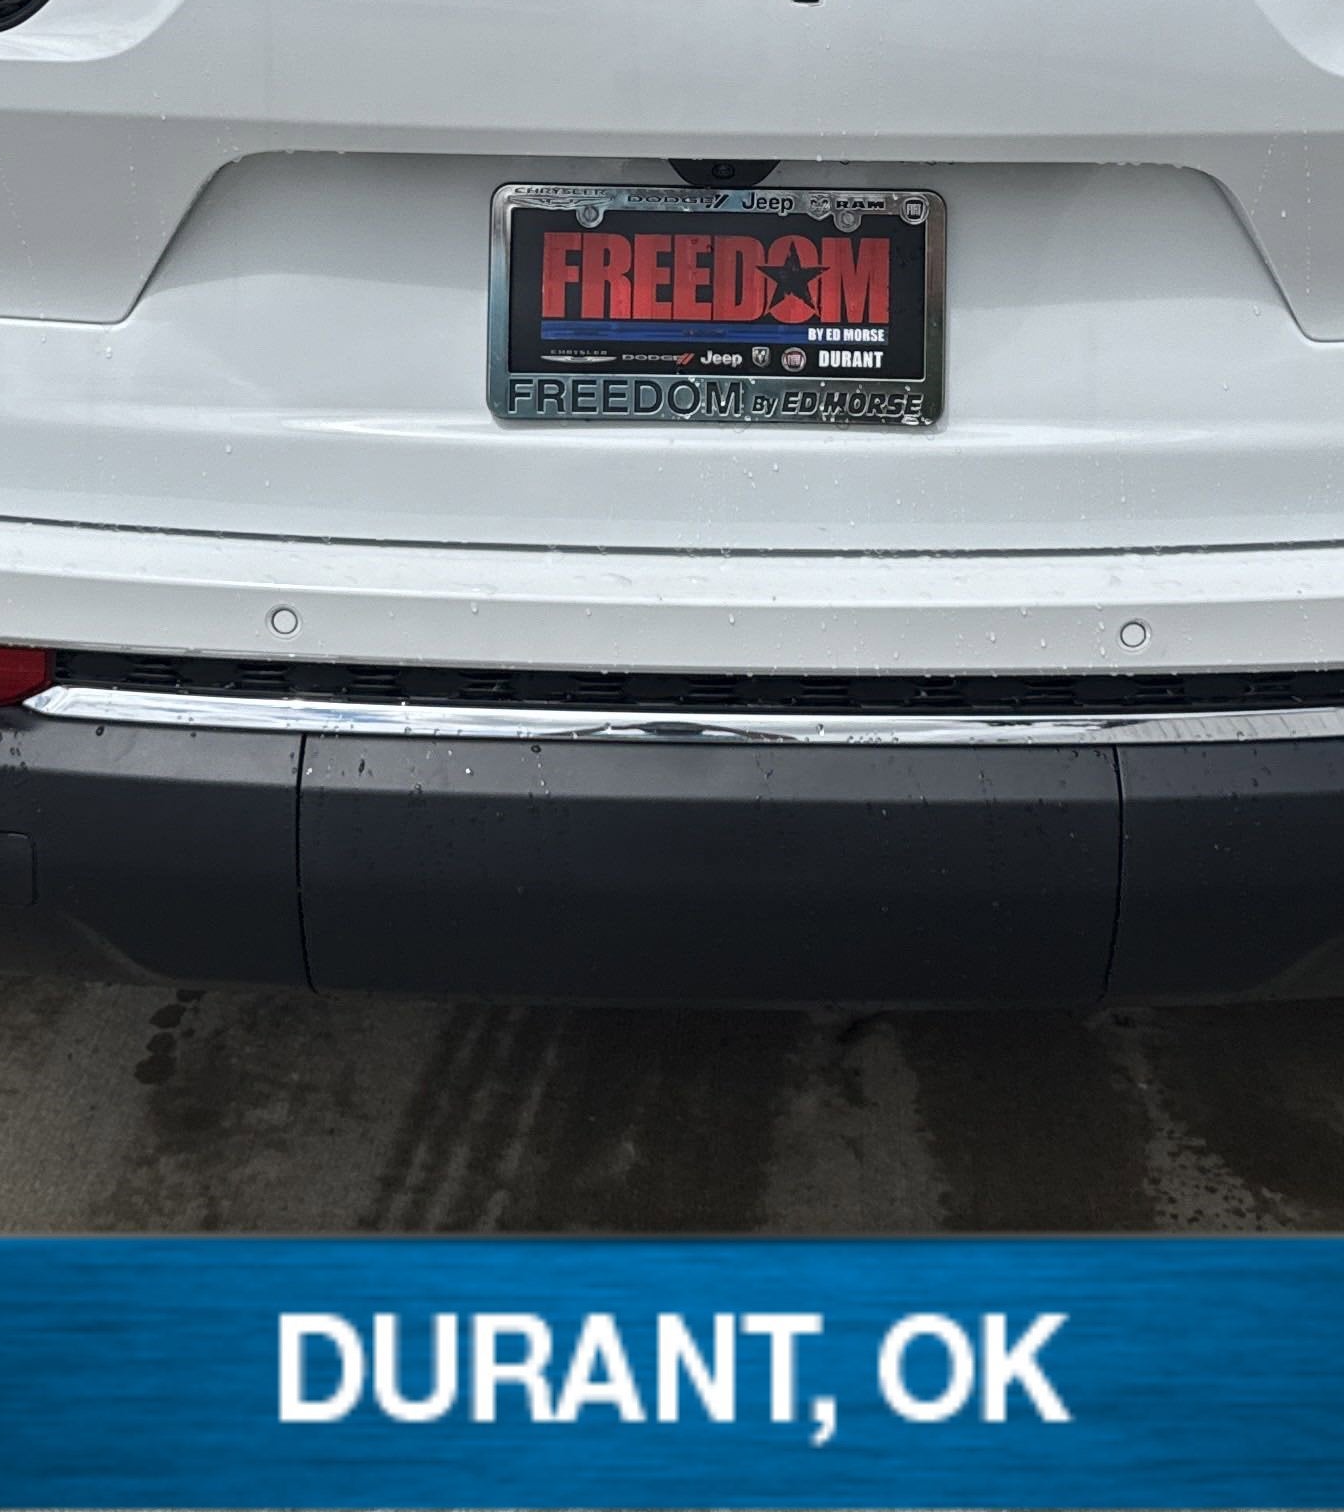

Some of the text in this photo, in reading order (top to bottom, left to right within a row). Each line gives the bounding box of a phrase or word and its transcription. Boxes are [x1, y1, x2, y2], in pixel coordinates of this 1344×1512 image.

[514, 187, 607, 196] CHRYSLER
[626, 193, 714, 205] DODGE
[741, 191, 795, 212] Jeep
[836, 199, 886, 210] RAM
[541, 231, 891, 324] FREEDOM
[807, 327, 886, 342] BY ED MORSE
[699, 349, 743, 367] Jeep
[818, 349, 884, 369] DURANT
[507, 377, 742, 417] FREEDOM
[781, 391, 818, 415] ED
[822, 391, 923, 418] MORSE
